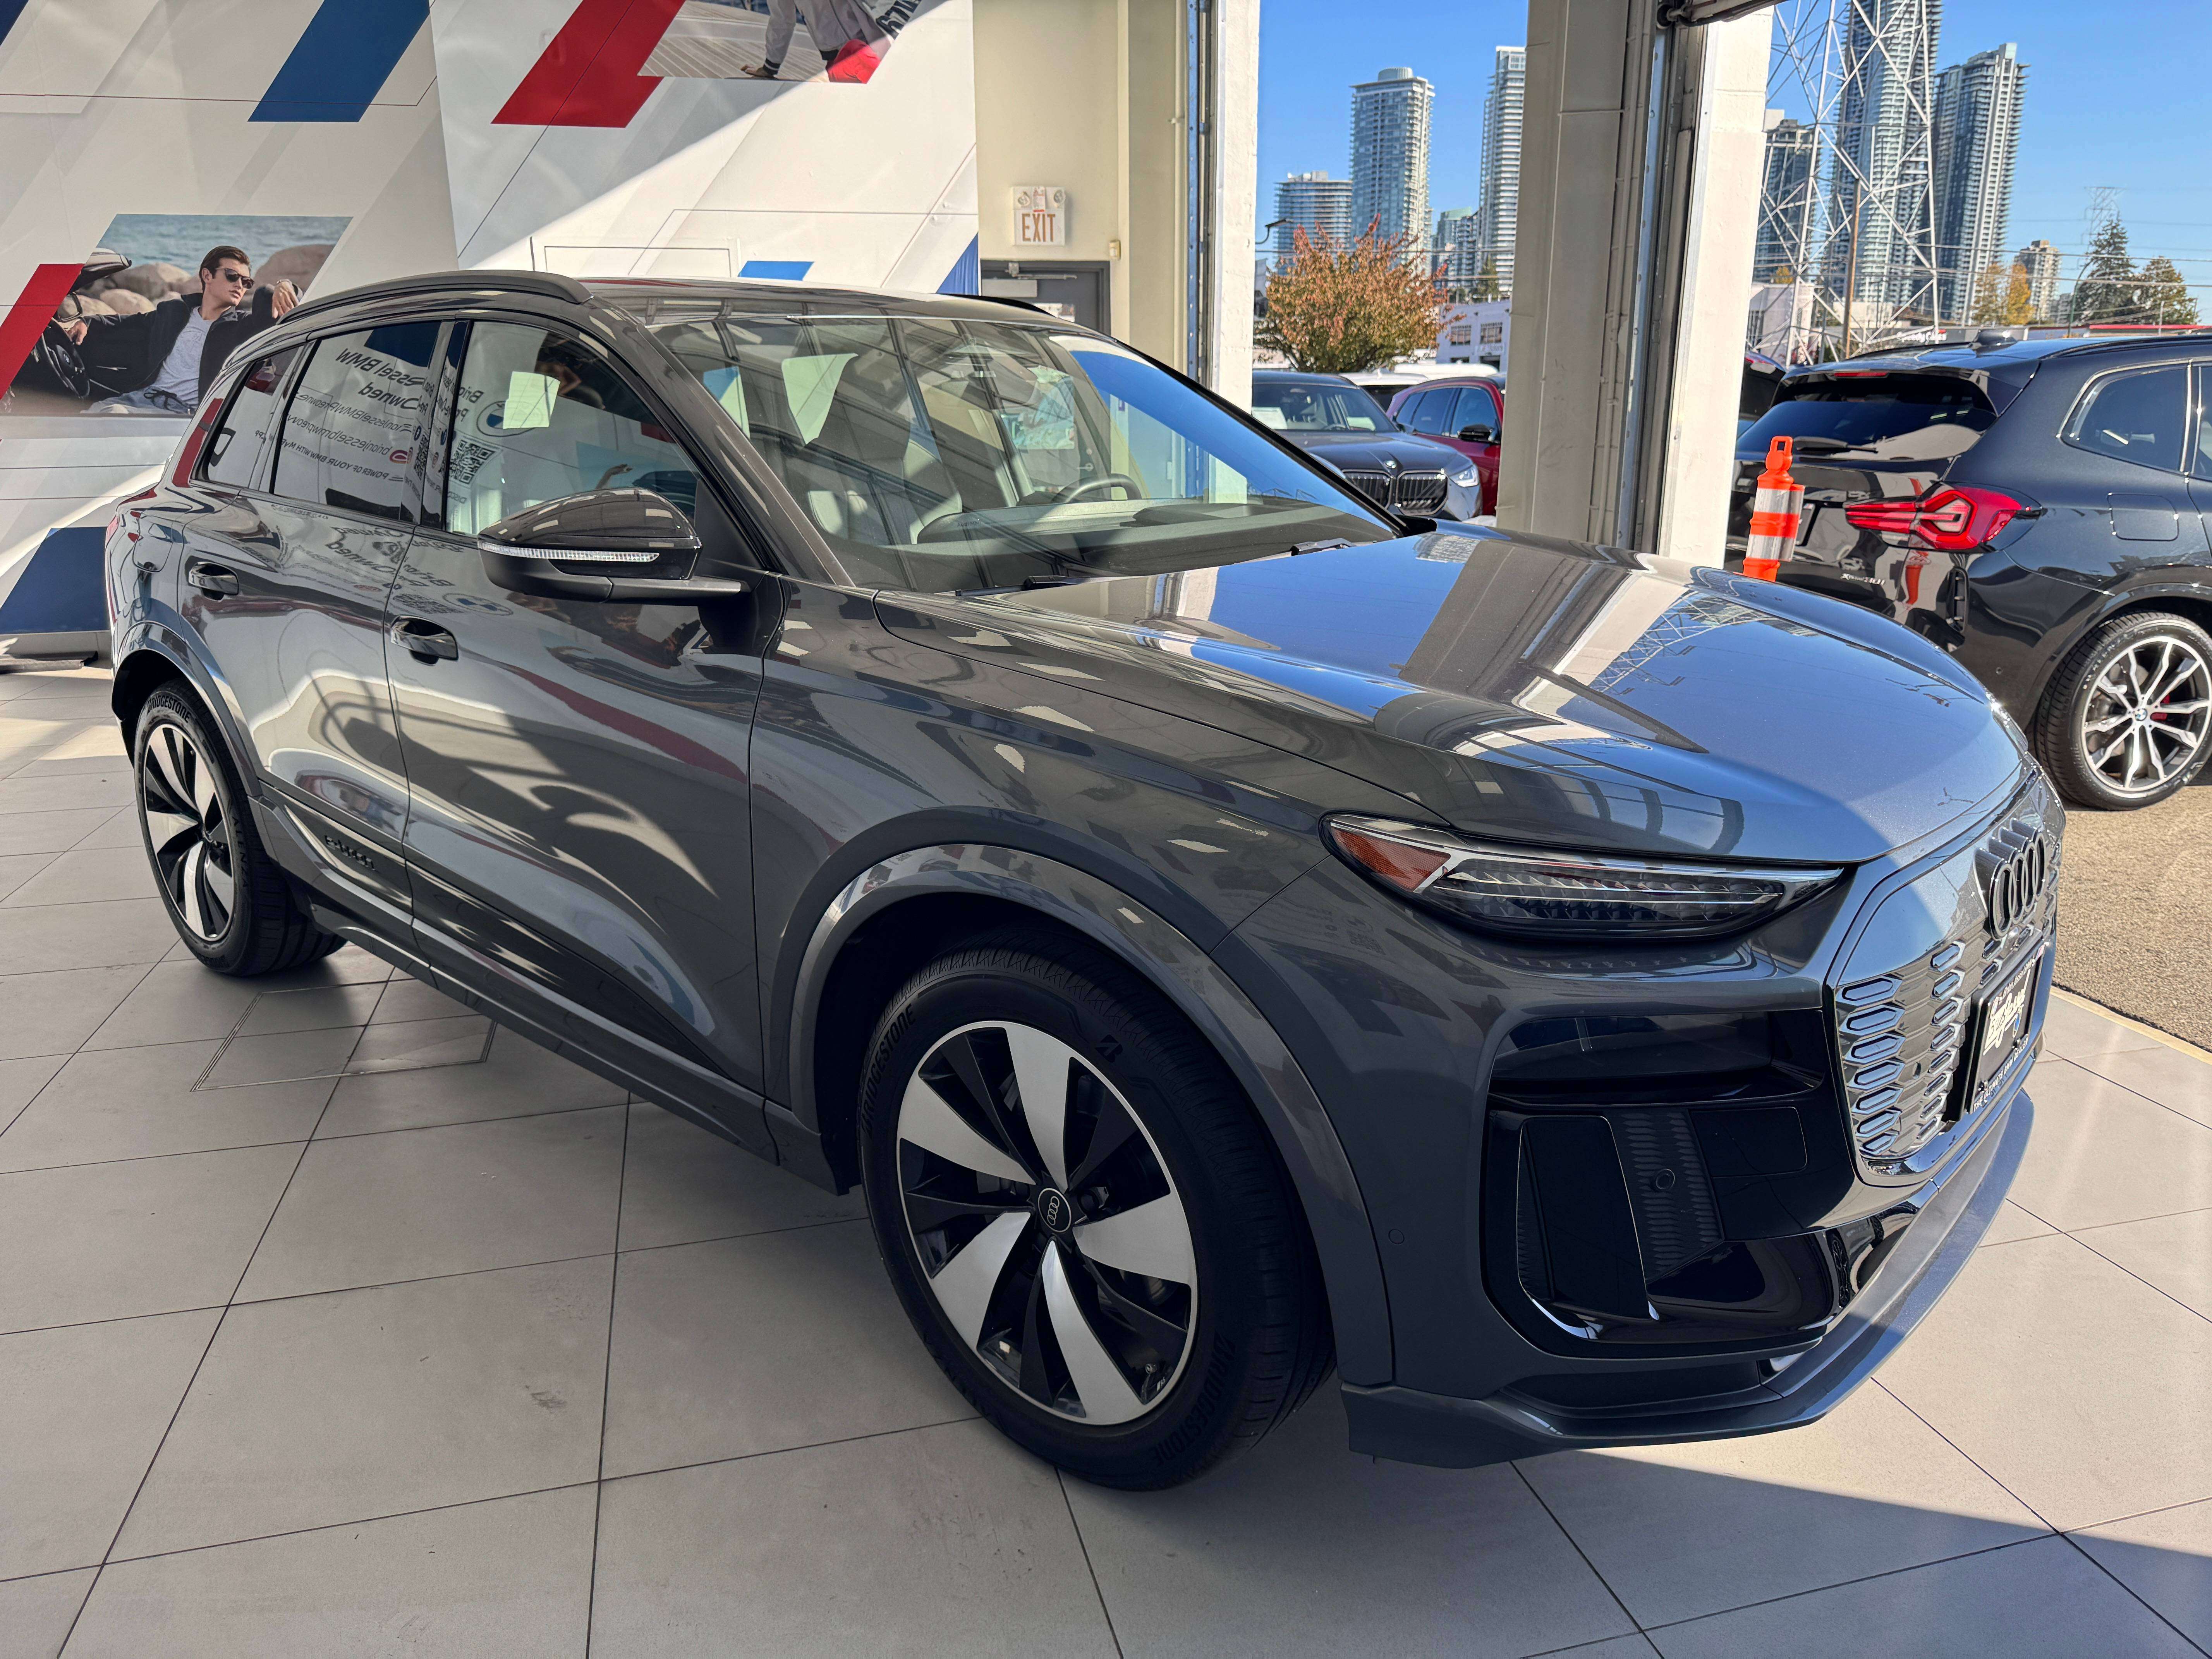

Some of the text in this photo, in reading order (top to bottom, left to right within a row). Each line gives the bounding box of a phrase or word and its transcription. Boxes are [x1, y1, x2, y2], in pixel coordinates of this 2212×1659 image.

[1022, 213, 1056, 242] EXIT
[147, 695, 191, 723] BRIDGESTONE
[232, 815, 249, 889] ALENZA
[860, 1003, 916, 1139] BRIDGESTONE
[1153, 1329, 1237, 1467] BRIDGESTONE
